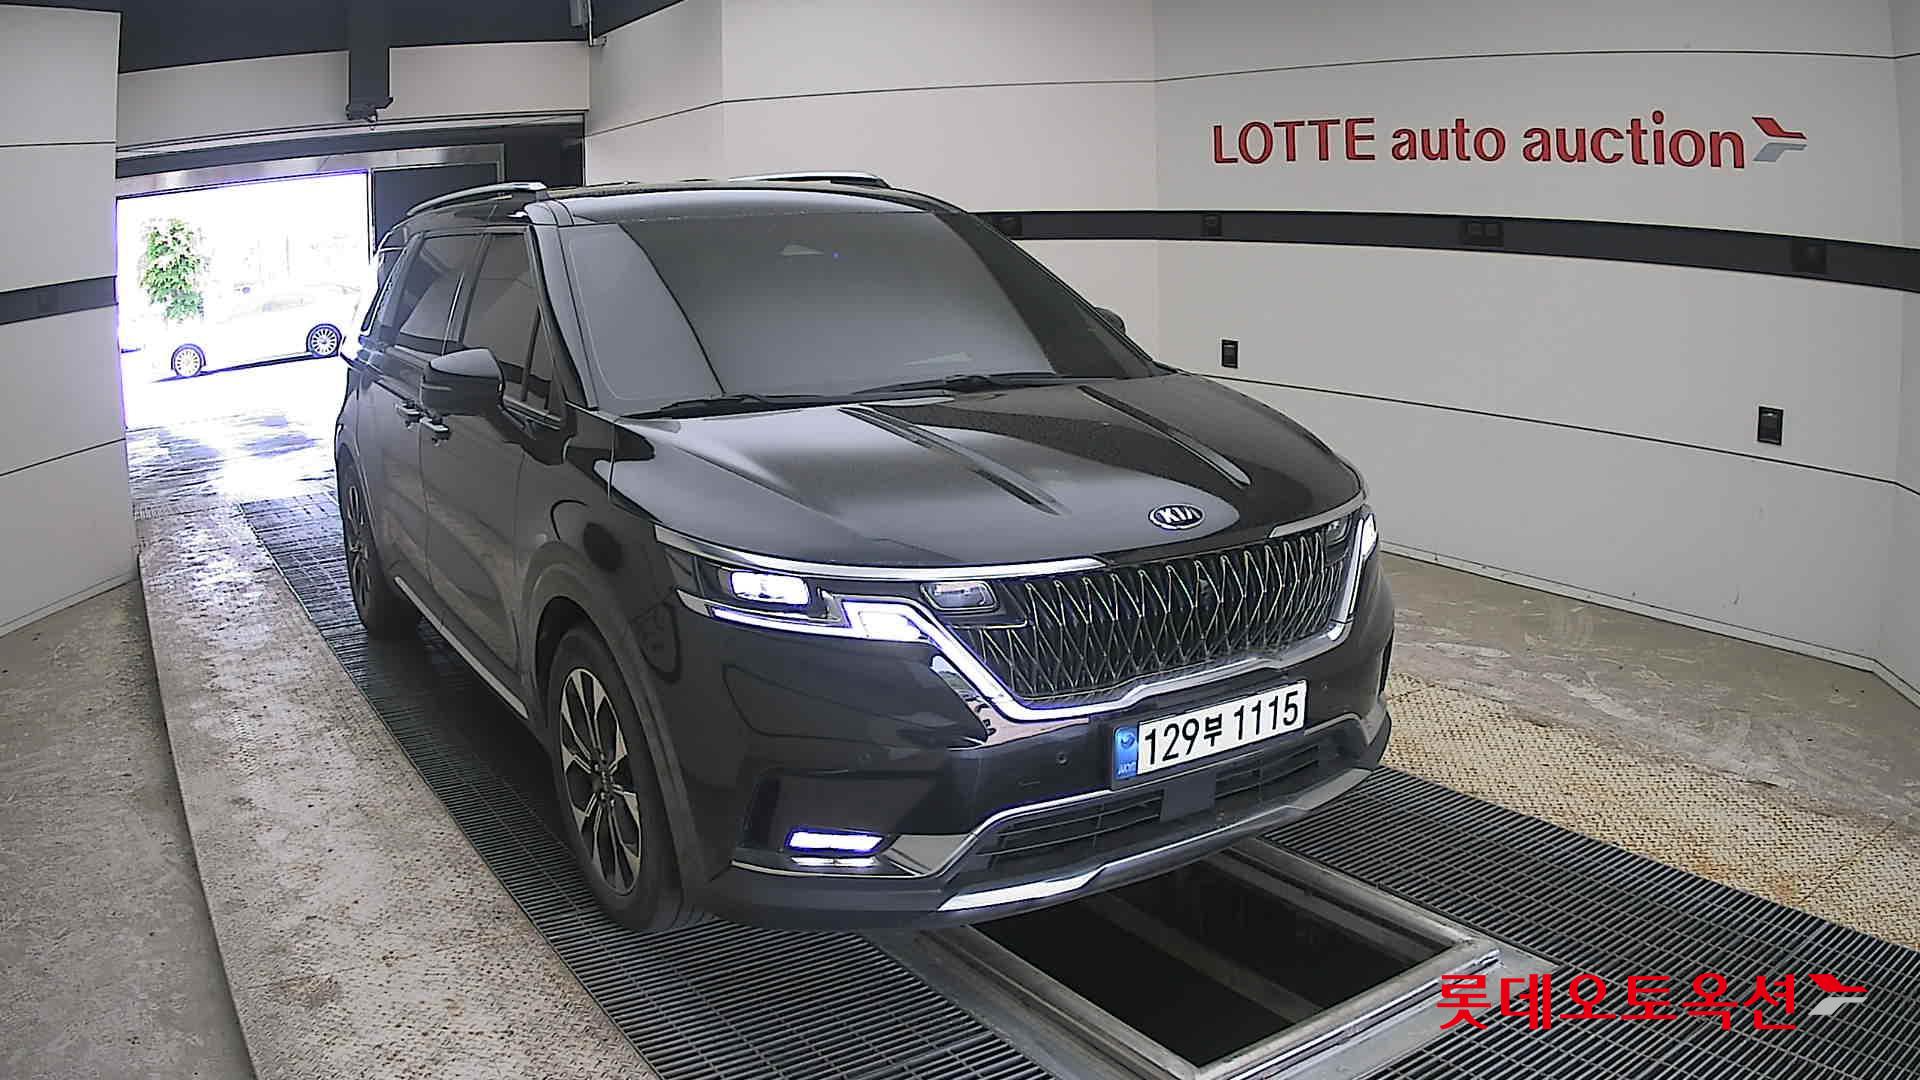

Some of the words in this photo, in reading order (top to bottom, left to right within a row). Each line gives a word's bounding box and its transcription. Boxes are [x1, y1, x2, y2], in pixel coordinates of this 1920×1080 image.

[1212, 117, 1376, 164] LOTTE
[1391, 117, 1507, 162] auto
[1521, 110, 1746, 169] auction
[1154, 506, 1201, 524] KIA
[1143, 713, 1223, 766] 129부
[1233, 690, 1299, 741] 1115
